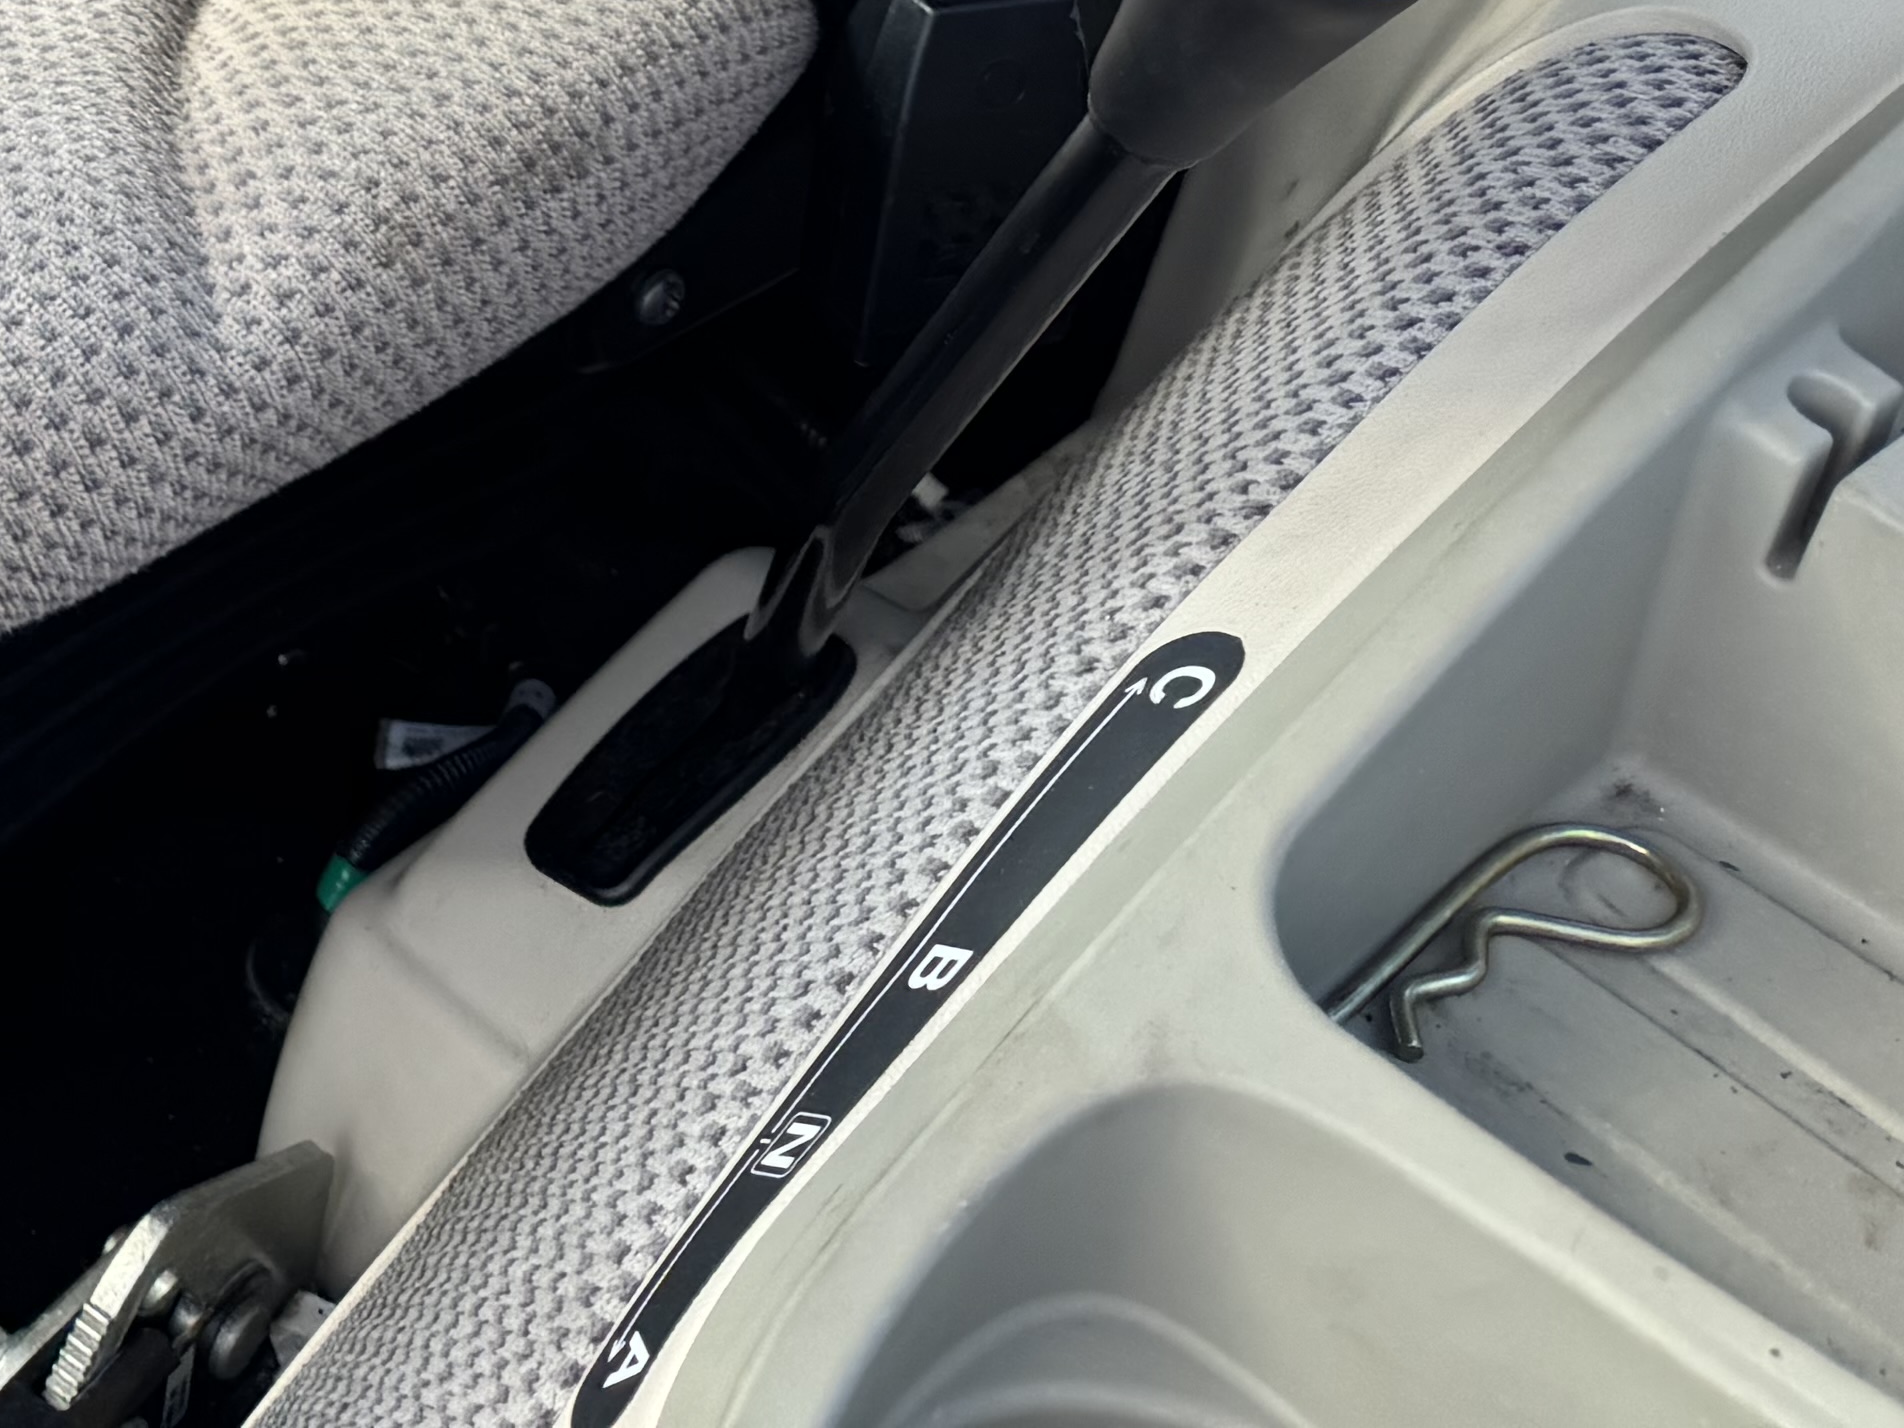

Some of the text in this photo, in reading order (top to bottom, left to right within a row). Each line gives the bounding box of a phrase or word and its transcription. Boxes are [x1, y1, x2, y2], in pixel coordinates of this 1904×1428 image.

[1149, 665, 1216, 710] C
[908, 943, 974, 992] B
[762, 1121, 822, 1170] N
[602, 1330, 651, 1388] A
